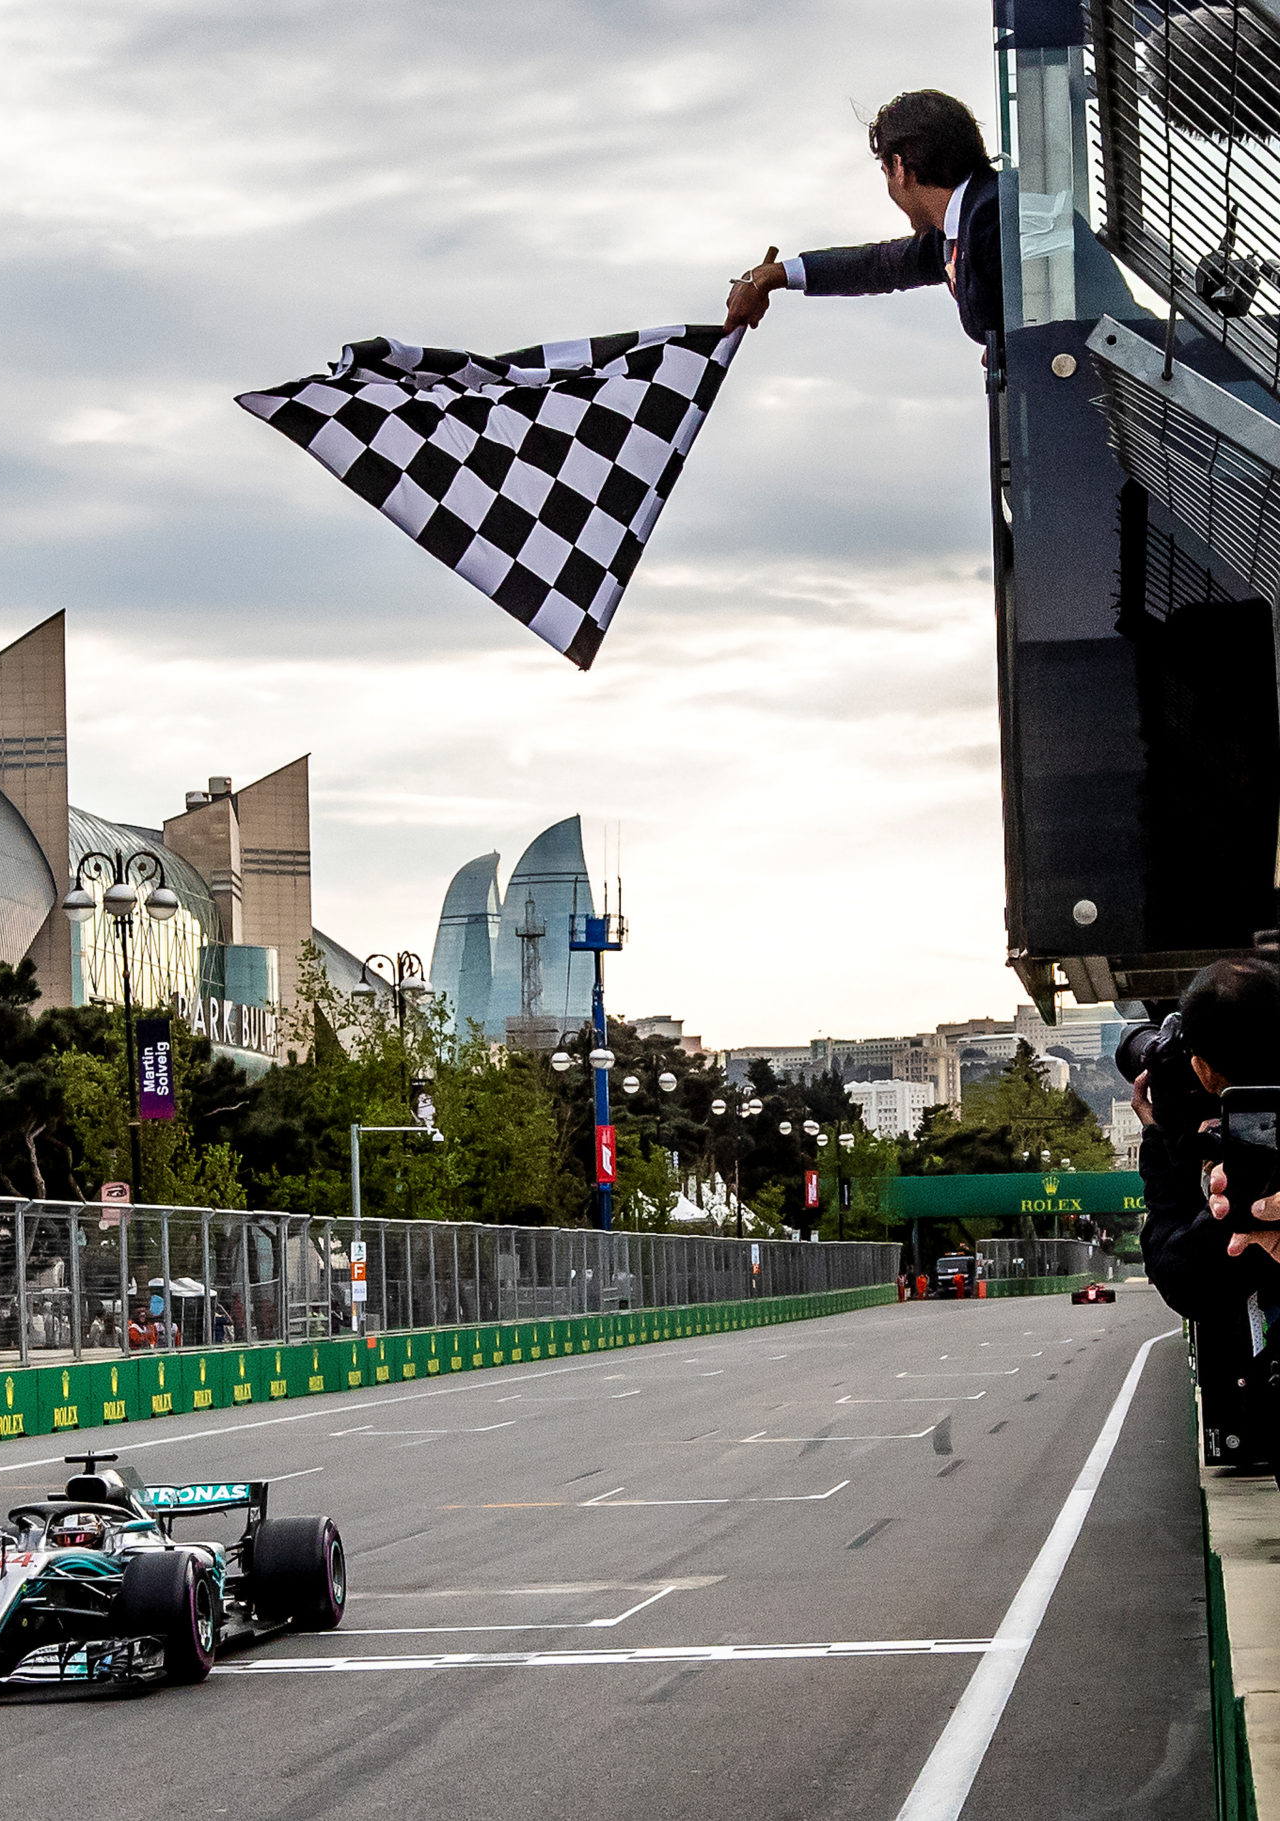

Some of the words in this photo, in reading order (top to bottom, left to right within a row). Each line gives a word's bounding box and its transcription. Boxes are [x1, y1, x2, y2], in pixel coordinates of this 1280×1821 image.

[179, 992, 237, 1046] PARK
[142, 1047, 156, 1092] Martin
[155, 1041, 170, 1096] Solveig
[1021, 1199, 1082, 1212] ROLEX
[1124, 1196, 1146, 1209] RO
[354, 1263, 364, 1279] F
[54, 1406, 78, 1427] ROLEX
[104, 1400, 126, 1420] ROLEX
